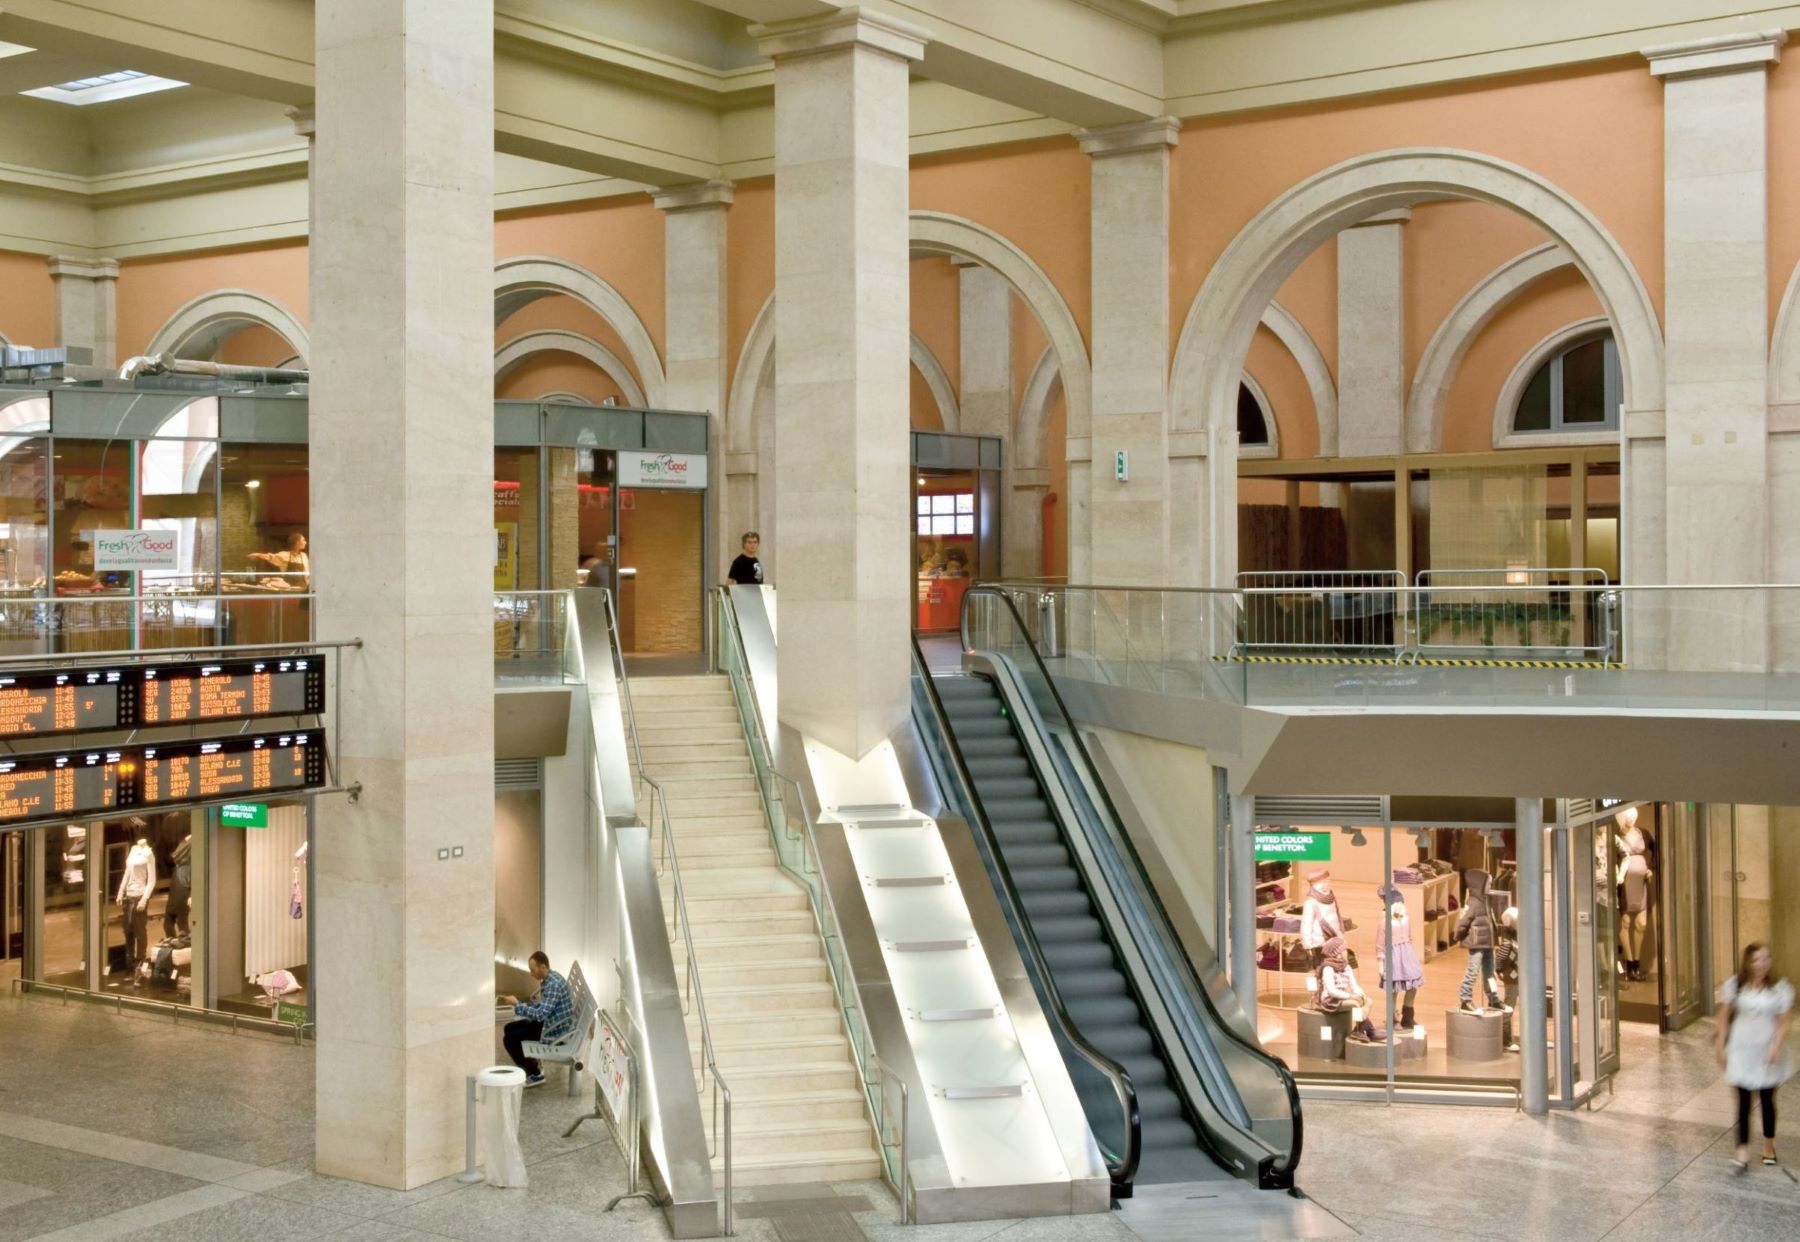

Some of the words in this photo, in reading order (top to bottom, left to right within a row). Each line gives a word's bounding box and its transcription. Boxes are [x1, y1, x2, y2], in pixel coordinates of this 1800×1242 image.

[640, 460, 659, 472] Fresh
[668, 460, 687, 473] Good
[98, 540, 128, 552] Fresh
[143, 539, 173, 552] Good
[1281, 836, 1313, 844] COLORS
